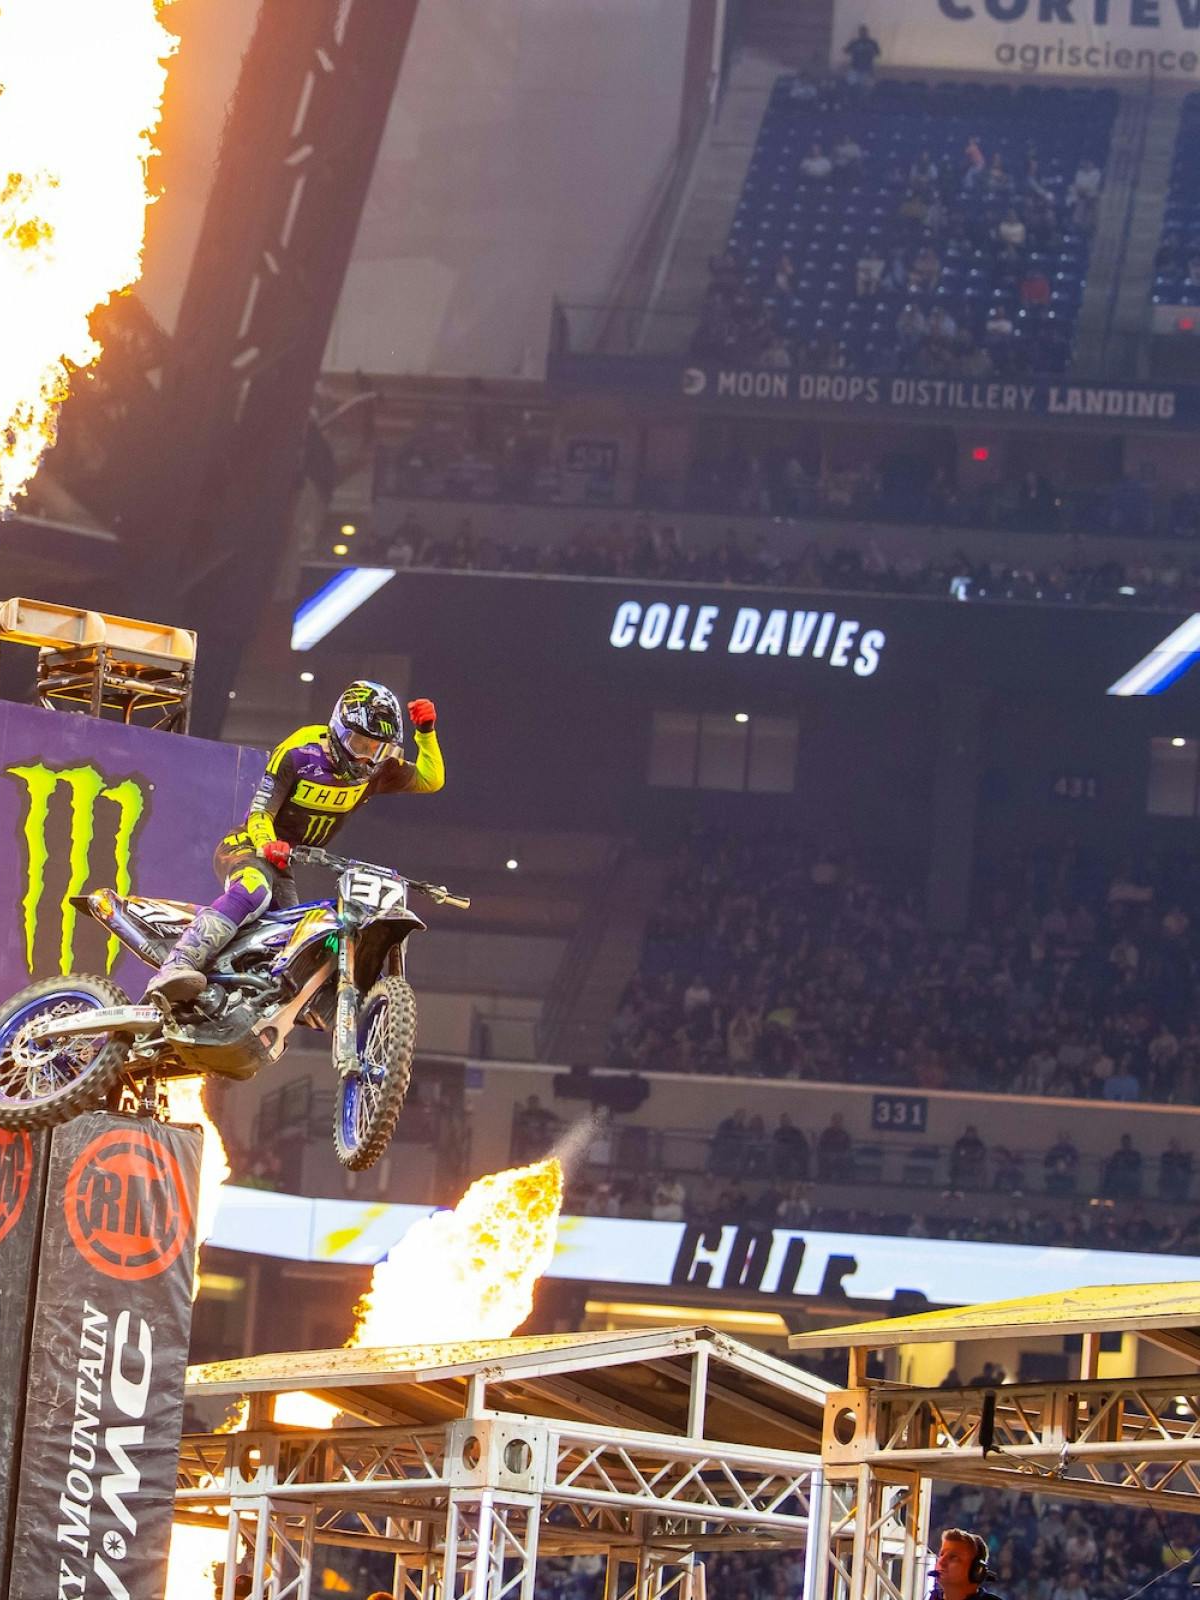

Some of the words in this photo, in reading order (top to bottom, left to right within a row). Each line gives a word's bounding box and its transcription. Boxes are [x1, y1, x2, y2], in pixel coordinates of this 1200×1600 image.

[717, 372, 788, 399] MOON
[798, 375, 880, 403] DROPS
[891, 379, 1035, 412] DISTILLERY
[1047, 388, 1176, 419] LANDING
[609, 600, 719, 652] COLE
[727, 606, 886, 677] DAVIES
[351, 872, 406, 911] 37
[876, 1100, 921, 1126] 331
[57, 1300, 109, 1558] MOUNTAIN
